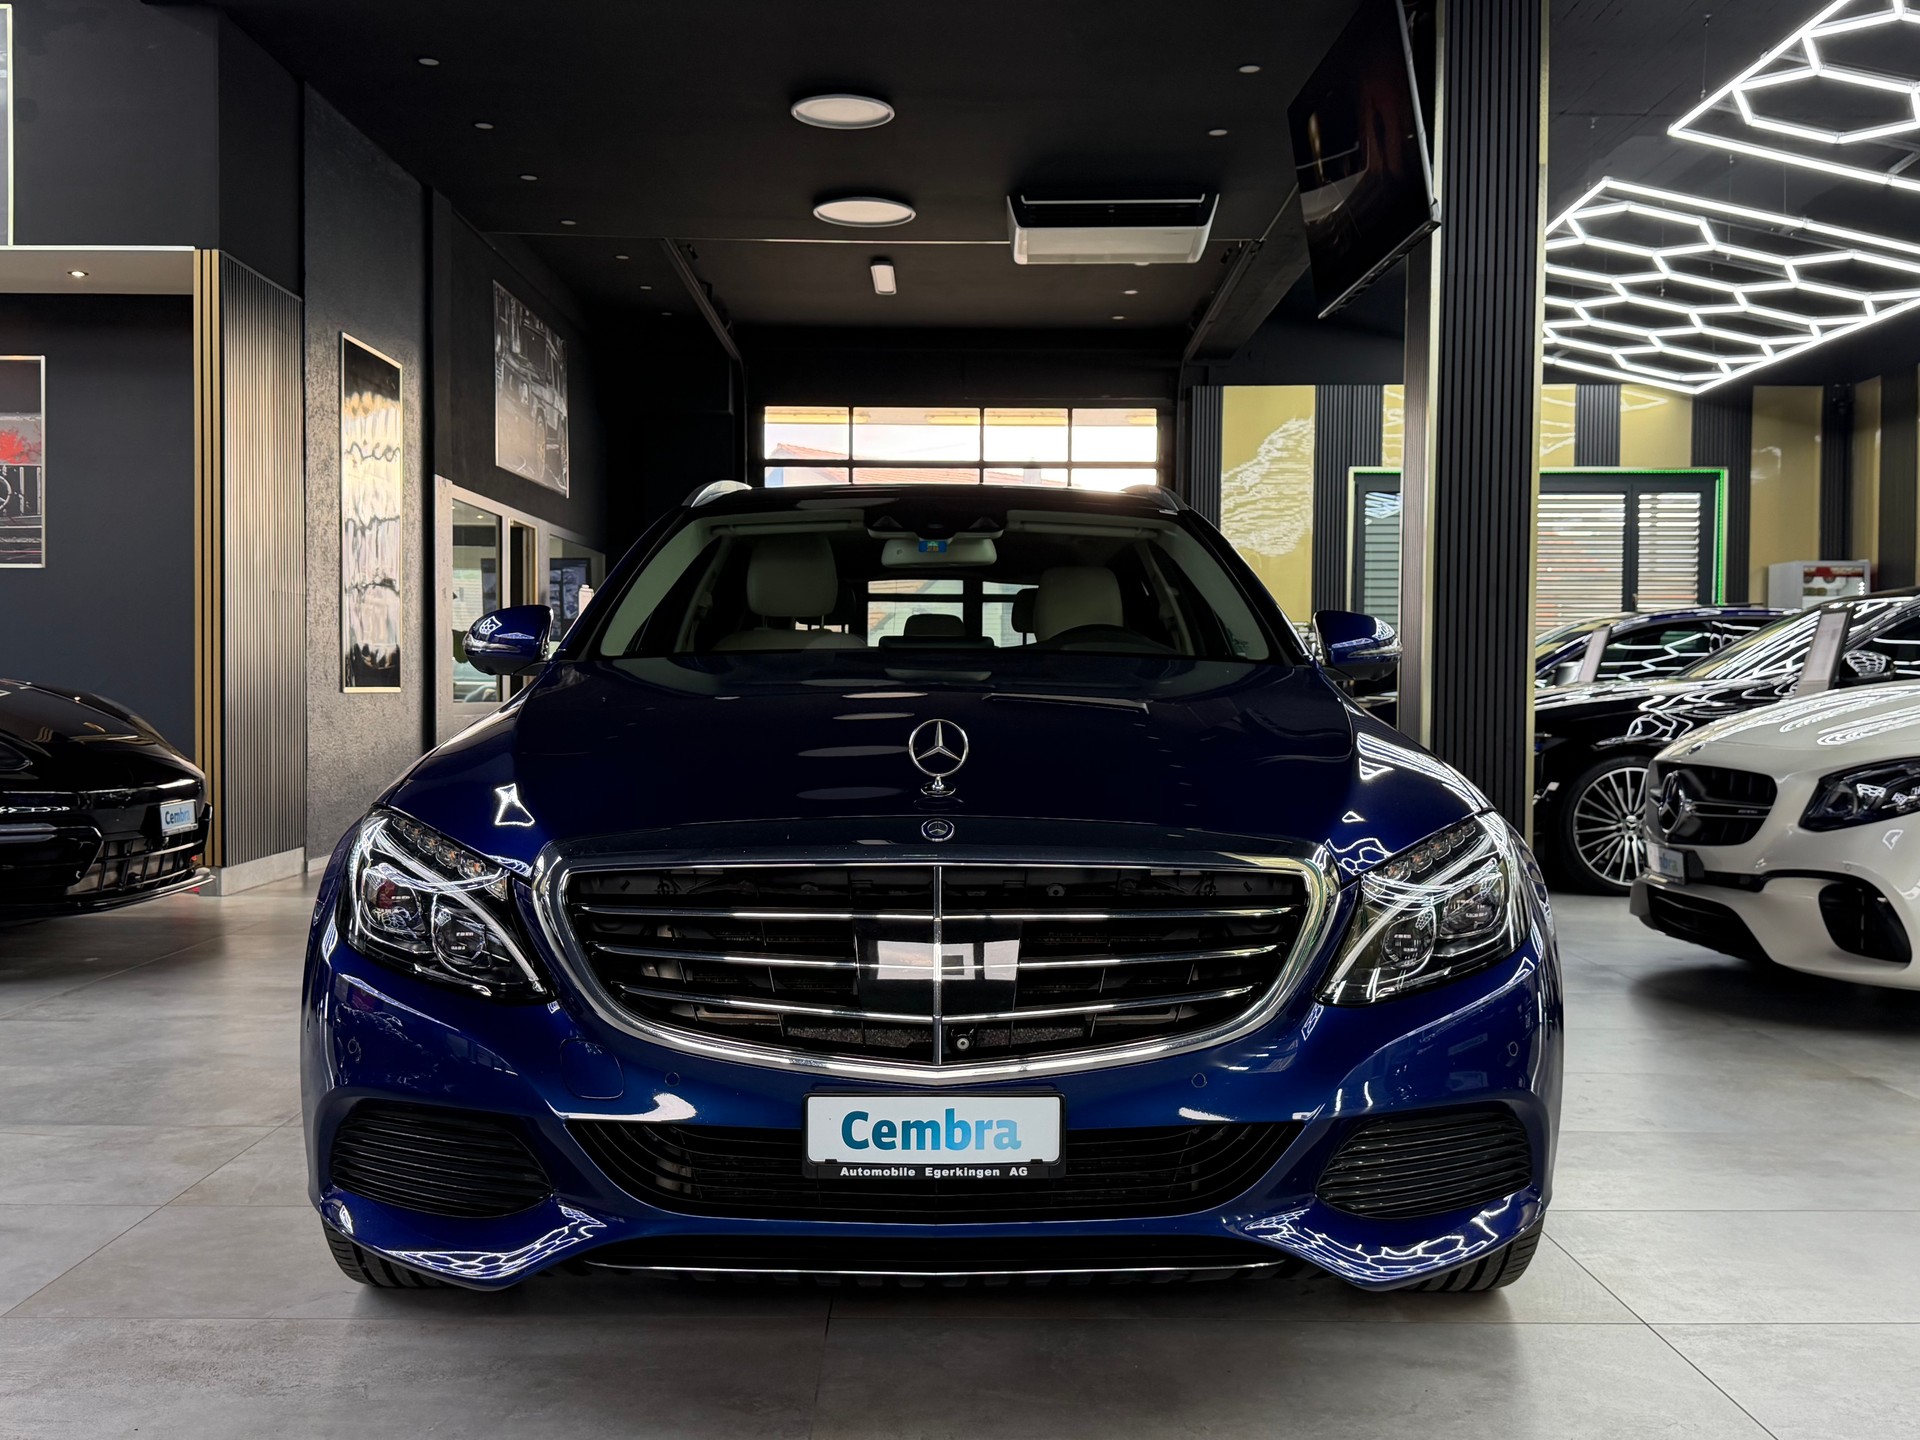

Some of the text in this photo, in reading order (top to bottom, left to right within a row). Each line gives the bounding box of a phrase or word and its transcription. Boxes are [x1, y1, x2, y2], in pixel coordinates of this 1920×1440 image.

[841, 1108, 1022, 1151] Cembra
[840, 1166, 1028, 1179] Automobile Egerkingen AG
